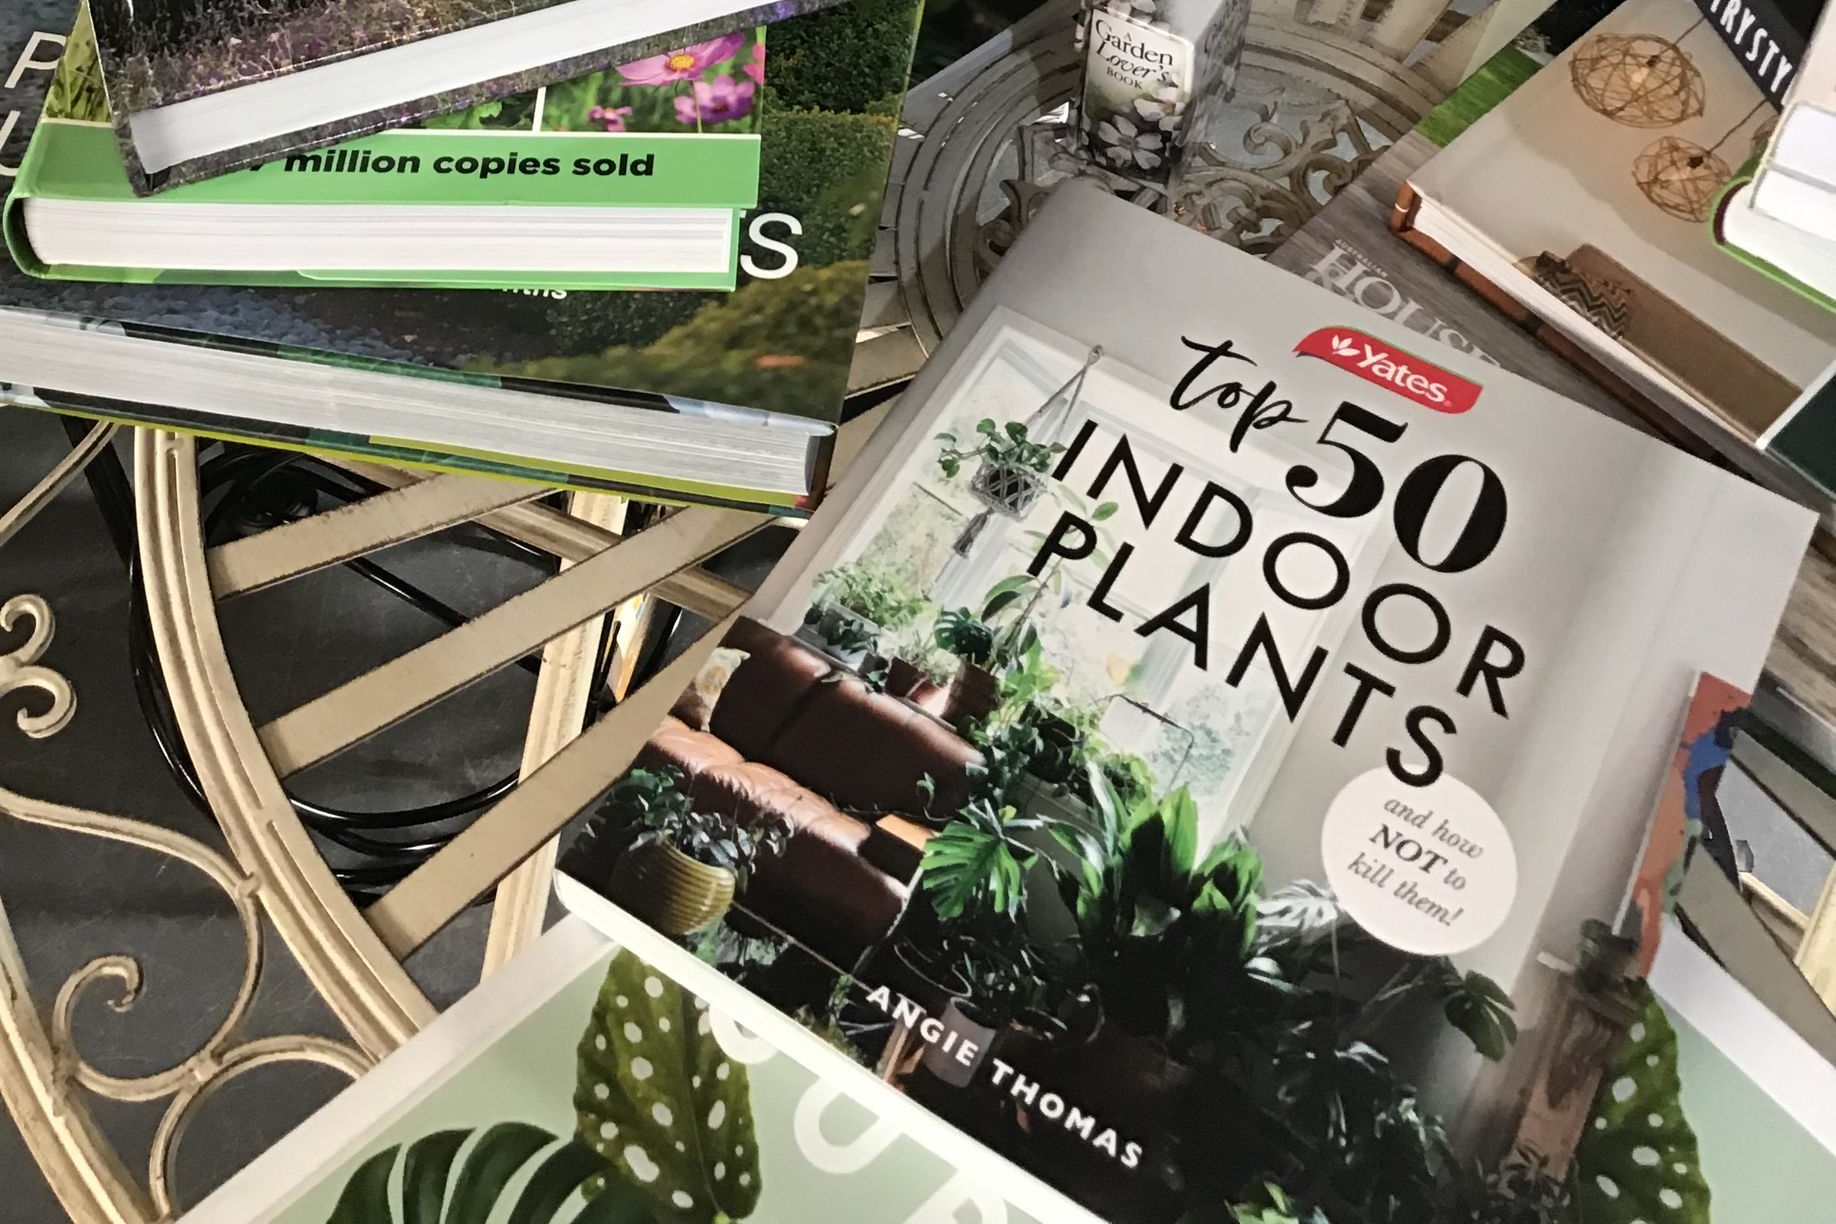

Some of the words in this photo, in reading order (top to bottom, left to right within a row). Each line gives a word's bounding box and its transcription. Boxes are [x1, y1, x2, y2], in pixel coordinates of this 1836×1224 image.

[1096, 19, 1174, 66] Garden
[1096, 40, 1170, 84] Lover's
[1746, 27, 1796, 106] STY
[1106, 66, 1144, 90] BOOK
[284, 150, 420, 175] million
[433, 153, 561, 180] copies
[573, 152, 655, 177] sold
[1356, 342, 1449, 404] Yates
[1169, 335, 1309, 453] top
[1285, 400, 1508, 574] 50
[1052, 418, 1526, 720] INDOOR
[1027, 510, 1458, 789] PLANTS
[1369, 823, 1449, 874] NOT
[1443, 867, 1467, 891] to
[1383, 797, 1434, 829] and
[1431, 818, 1484, 860] how
[1347, 850, 1395, 889] kill
[1393, 879, 1464, 927] them!
[865, 984, 979, 1068] ANGIE
[992, 1057, 1143, 1170] THOMAS
